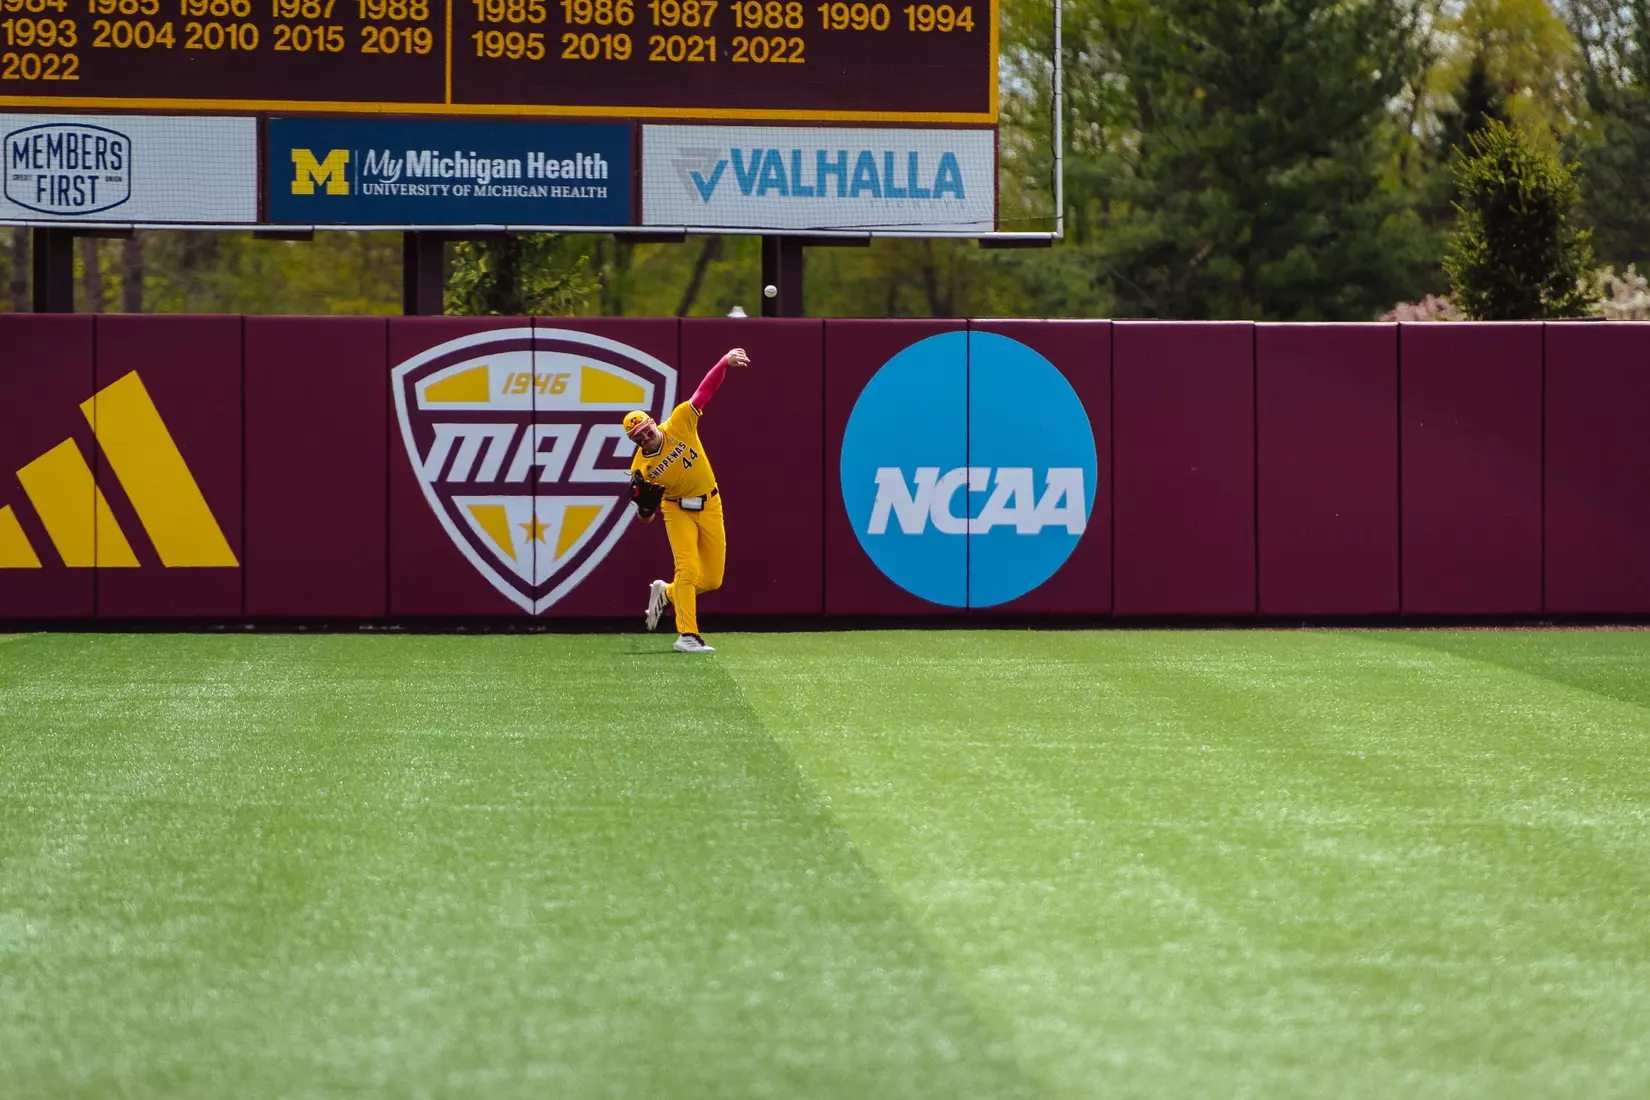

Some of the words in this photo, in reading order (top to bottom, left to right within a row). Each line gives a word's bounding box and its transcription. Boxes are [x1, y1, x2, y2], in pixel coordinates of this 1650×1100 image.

[180, 0, 250, 17] 1986
[271, 0, 337, 19] 1987
[357, 0, 429, 20] 1988
[472, 0, 546, 23] 1985
[560, 0, 634, 26] 1986
[648, 0, 718, 27] 1987
[730, 1, 804, 29] 1988
[817, 2, 890, 31] 1990
[904, 4, 975, 32] 1994
[1, 18, 77, 47] 1993
[92, 20, 176, 48] 2004
[184, 22, 259, 50] 2010
[273, 24, 345, 52] 2015
[360, 26, 433, 54] 2019
[471, 30, 545, 60] 1995
[561, 33, 632, 60] 2019
[649, 35, 717, 62] 2021
[732, 36, 805, 63] 2022
[1, 52, 80, 80] 2022
[12, 132, 123, 170] MEMBERS
[527, 152, 608, 179] Health
[291, 149, 349, 195] M
[731, 148, 965, 199] VALHALLA
[37, 174, 99, 206] FIRST
[363, 183, 450, 196] UNIVERSITY
[452, 184, 471, 196] OF
[473, 185, 548, 197] MICHIGAN
[551, 186, 607, 198] HEALTH
[502, 372, 571, 395] 1946
[424, 423, 636, 482] MAC
[648, 442, 686, 479] CHIPPEWAS
[682, 448, 698, 469] 44
[867, 467, 1087, 534] NCAA
